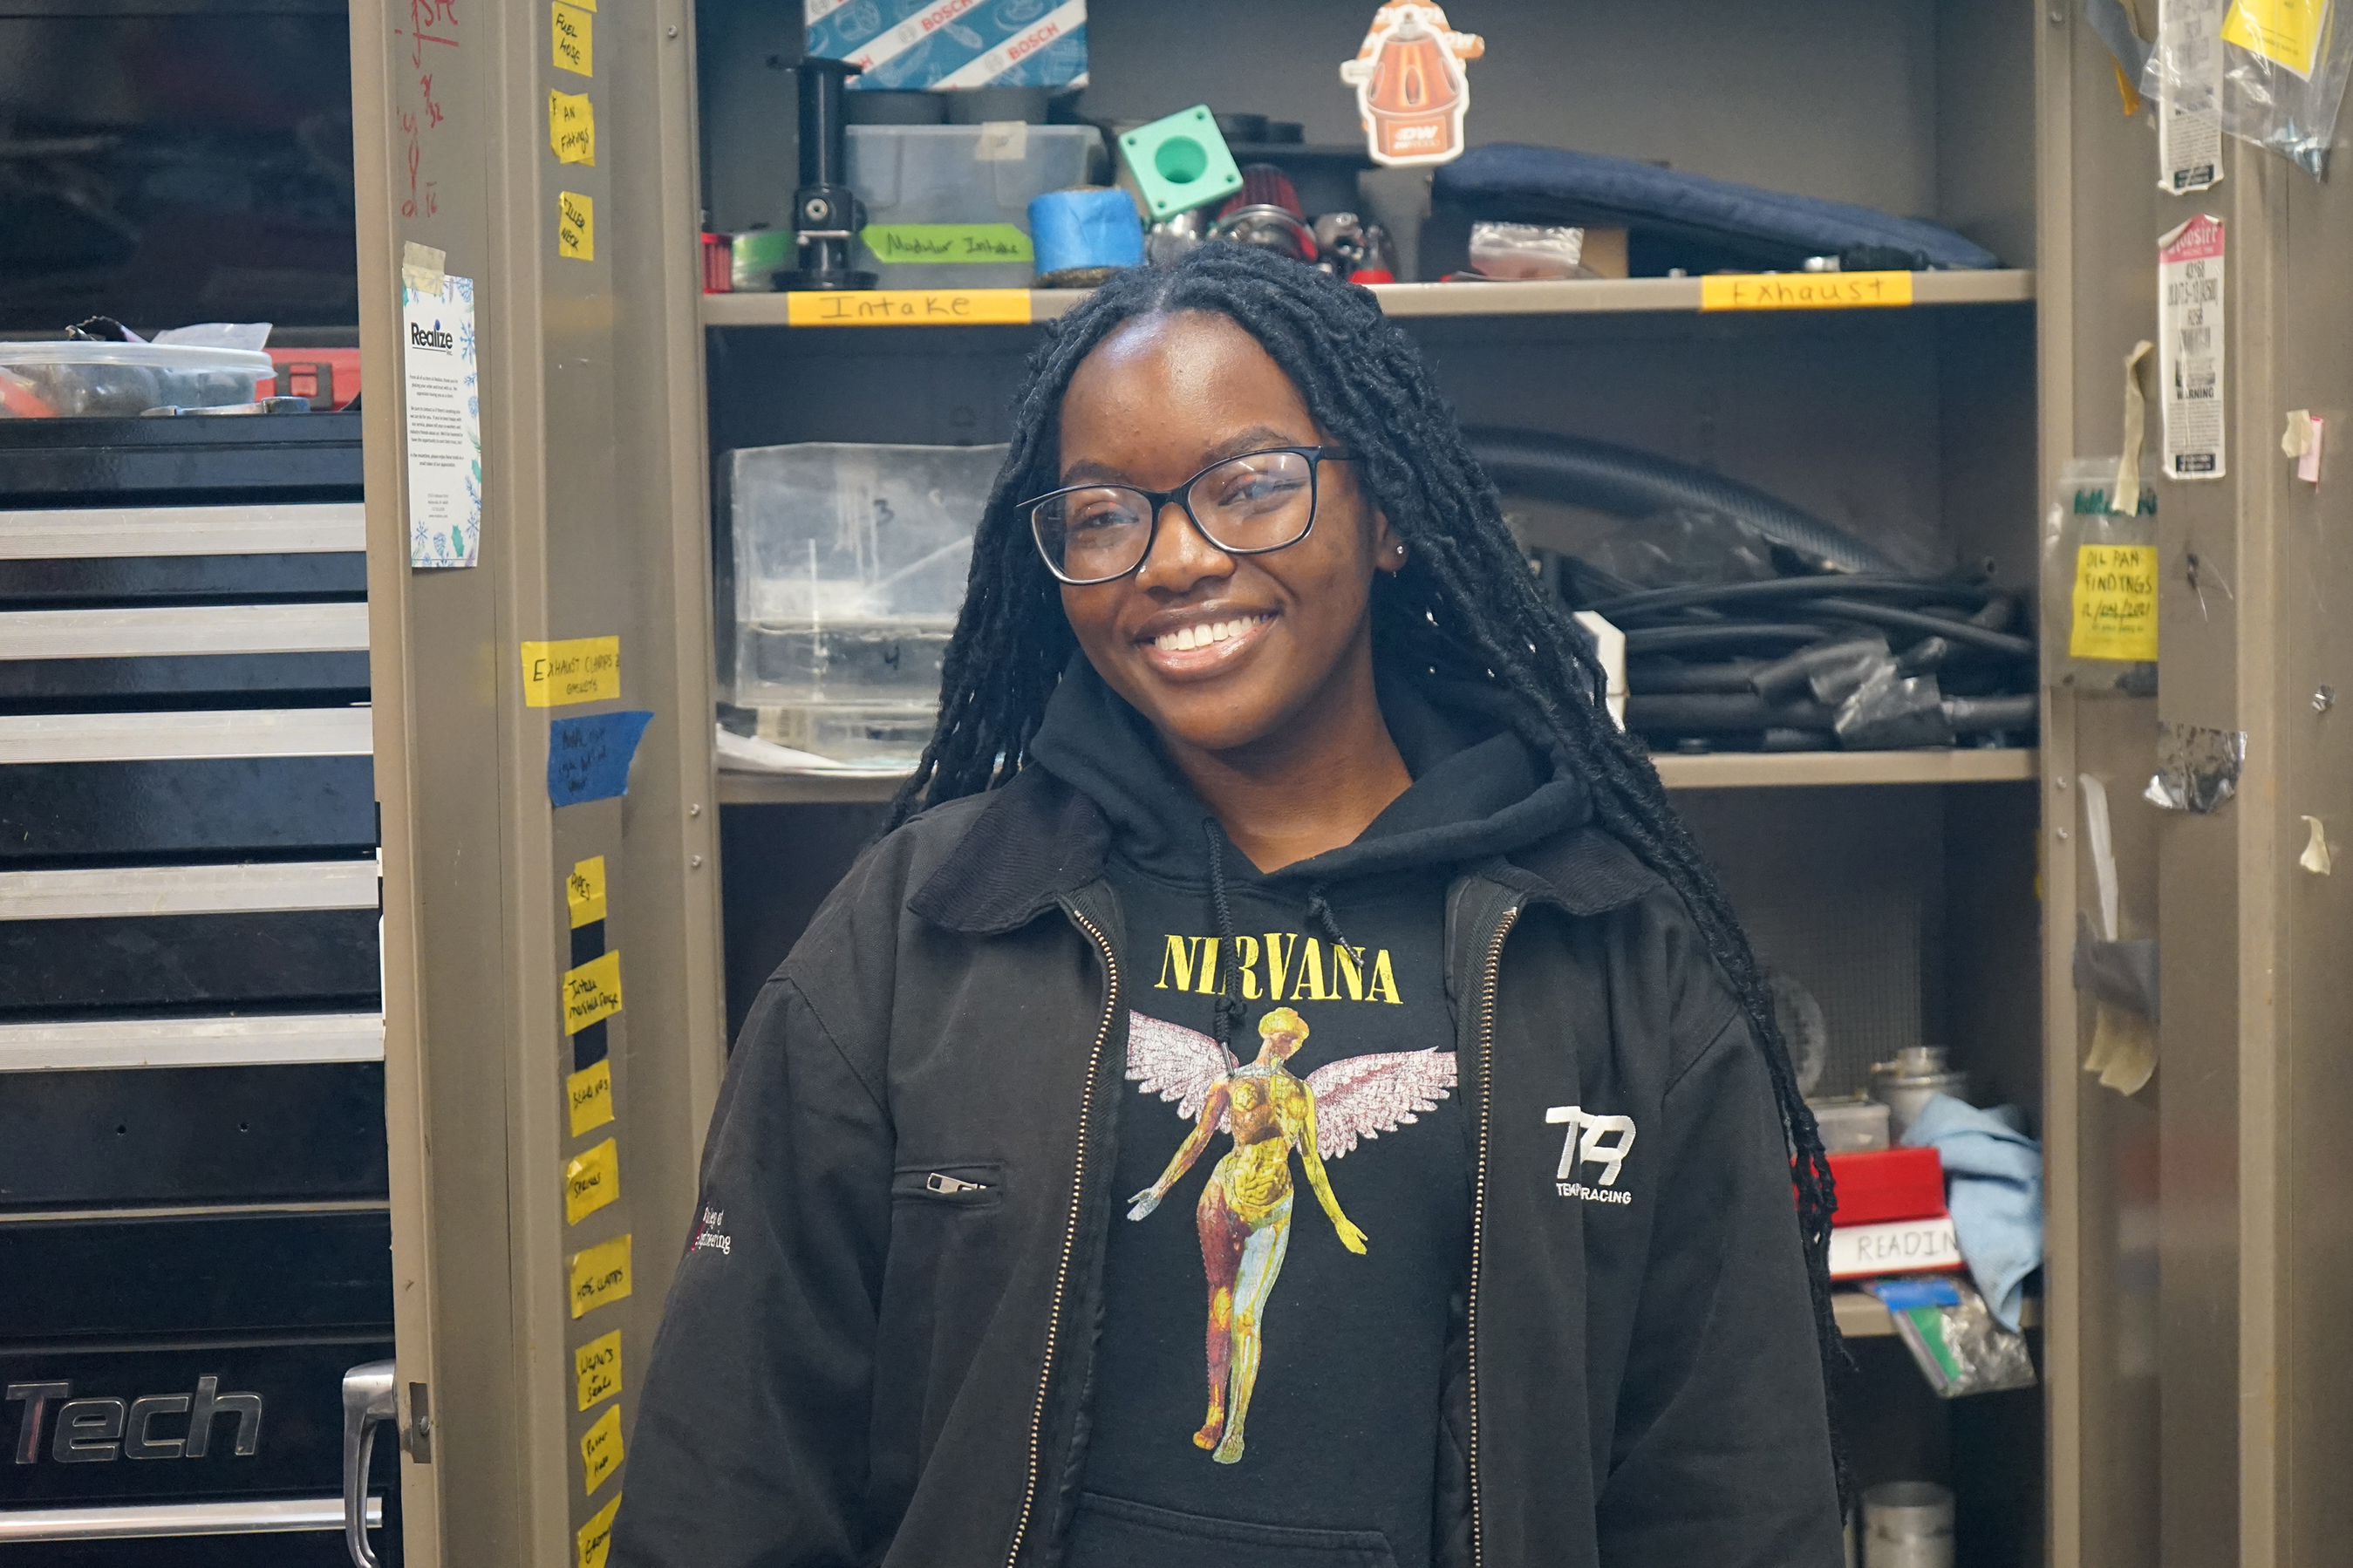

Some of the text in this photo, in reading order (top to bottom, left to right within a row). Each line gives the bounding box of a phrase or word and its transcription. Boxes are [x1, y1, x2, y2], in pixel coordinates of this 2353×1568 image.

[556, 13, 577, 37] FUEL
[1007, 23, 1061, 60] BOSCH
[1732, 279, 1886, 304] Exhaust
[820, 297, 972, 319] Intake
[411, 319, 454, 349] Realize
[2086, 549, 2139, 569] OIL PAN
[1155, 932, 1404, 1005] NIRVANA
[1580, 1187, 1632, 1205] RACING
[7, 1374, 263, 1465] Tech
